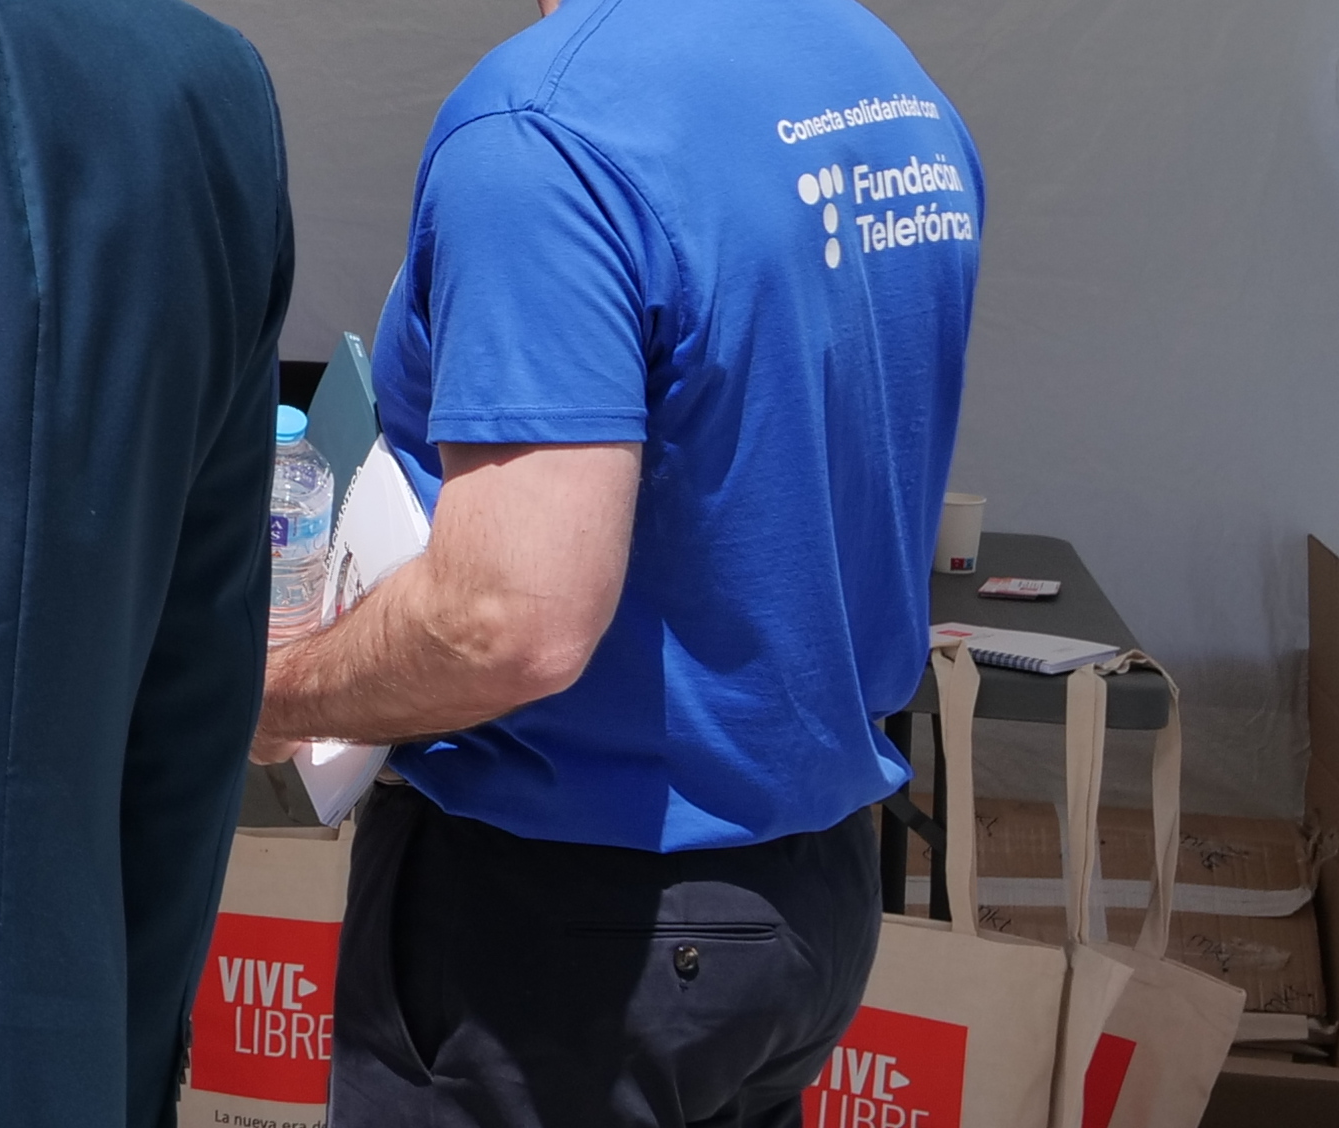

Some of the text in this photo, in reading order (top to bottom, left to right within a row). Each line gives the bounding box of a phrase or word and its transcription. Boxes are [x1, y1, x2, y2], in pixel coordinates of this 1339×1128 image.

[777, 93, 941, 145] Conecta solidaridad con
[218, 956, 305, 1011] VIVE
[235, 1005, 334, 1061] LIBRE
[811, 1045, 897, 1102] IVE
[214, 1109, 230, 1124] La
